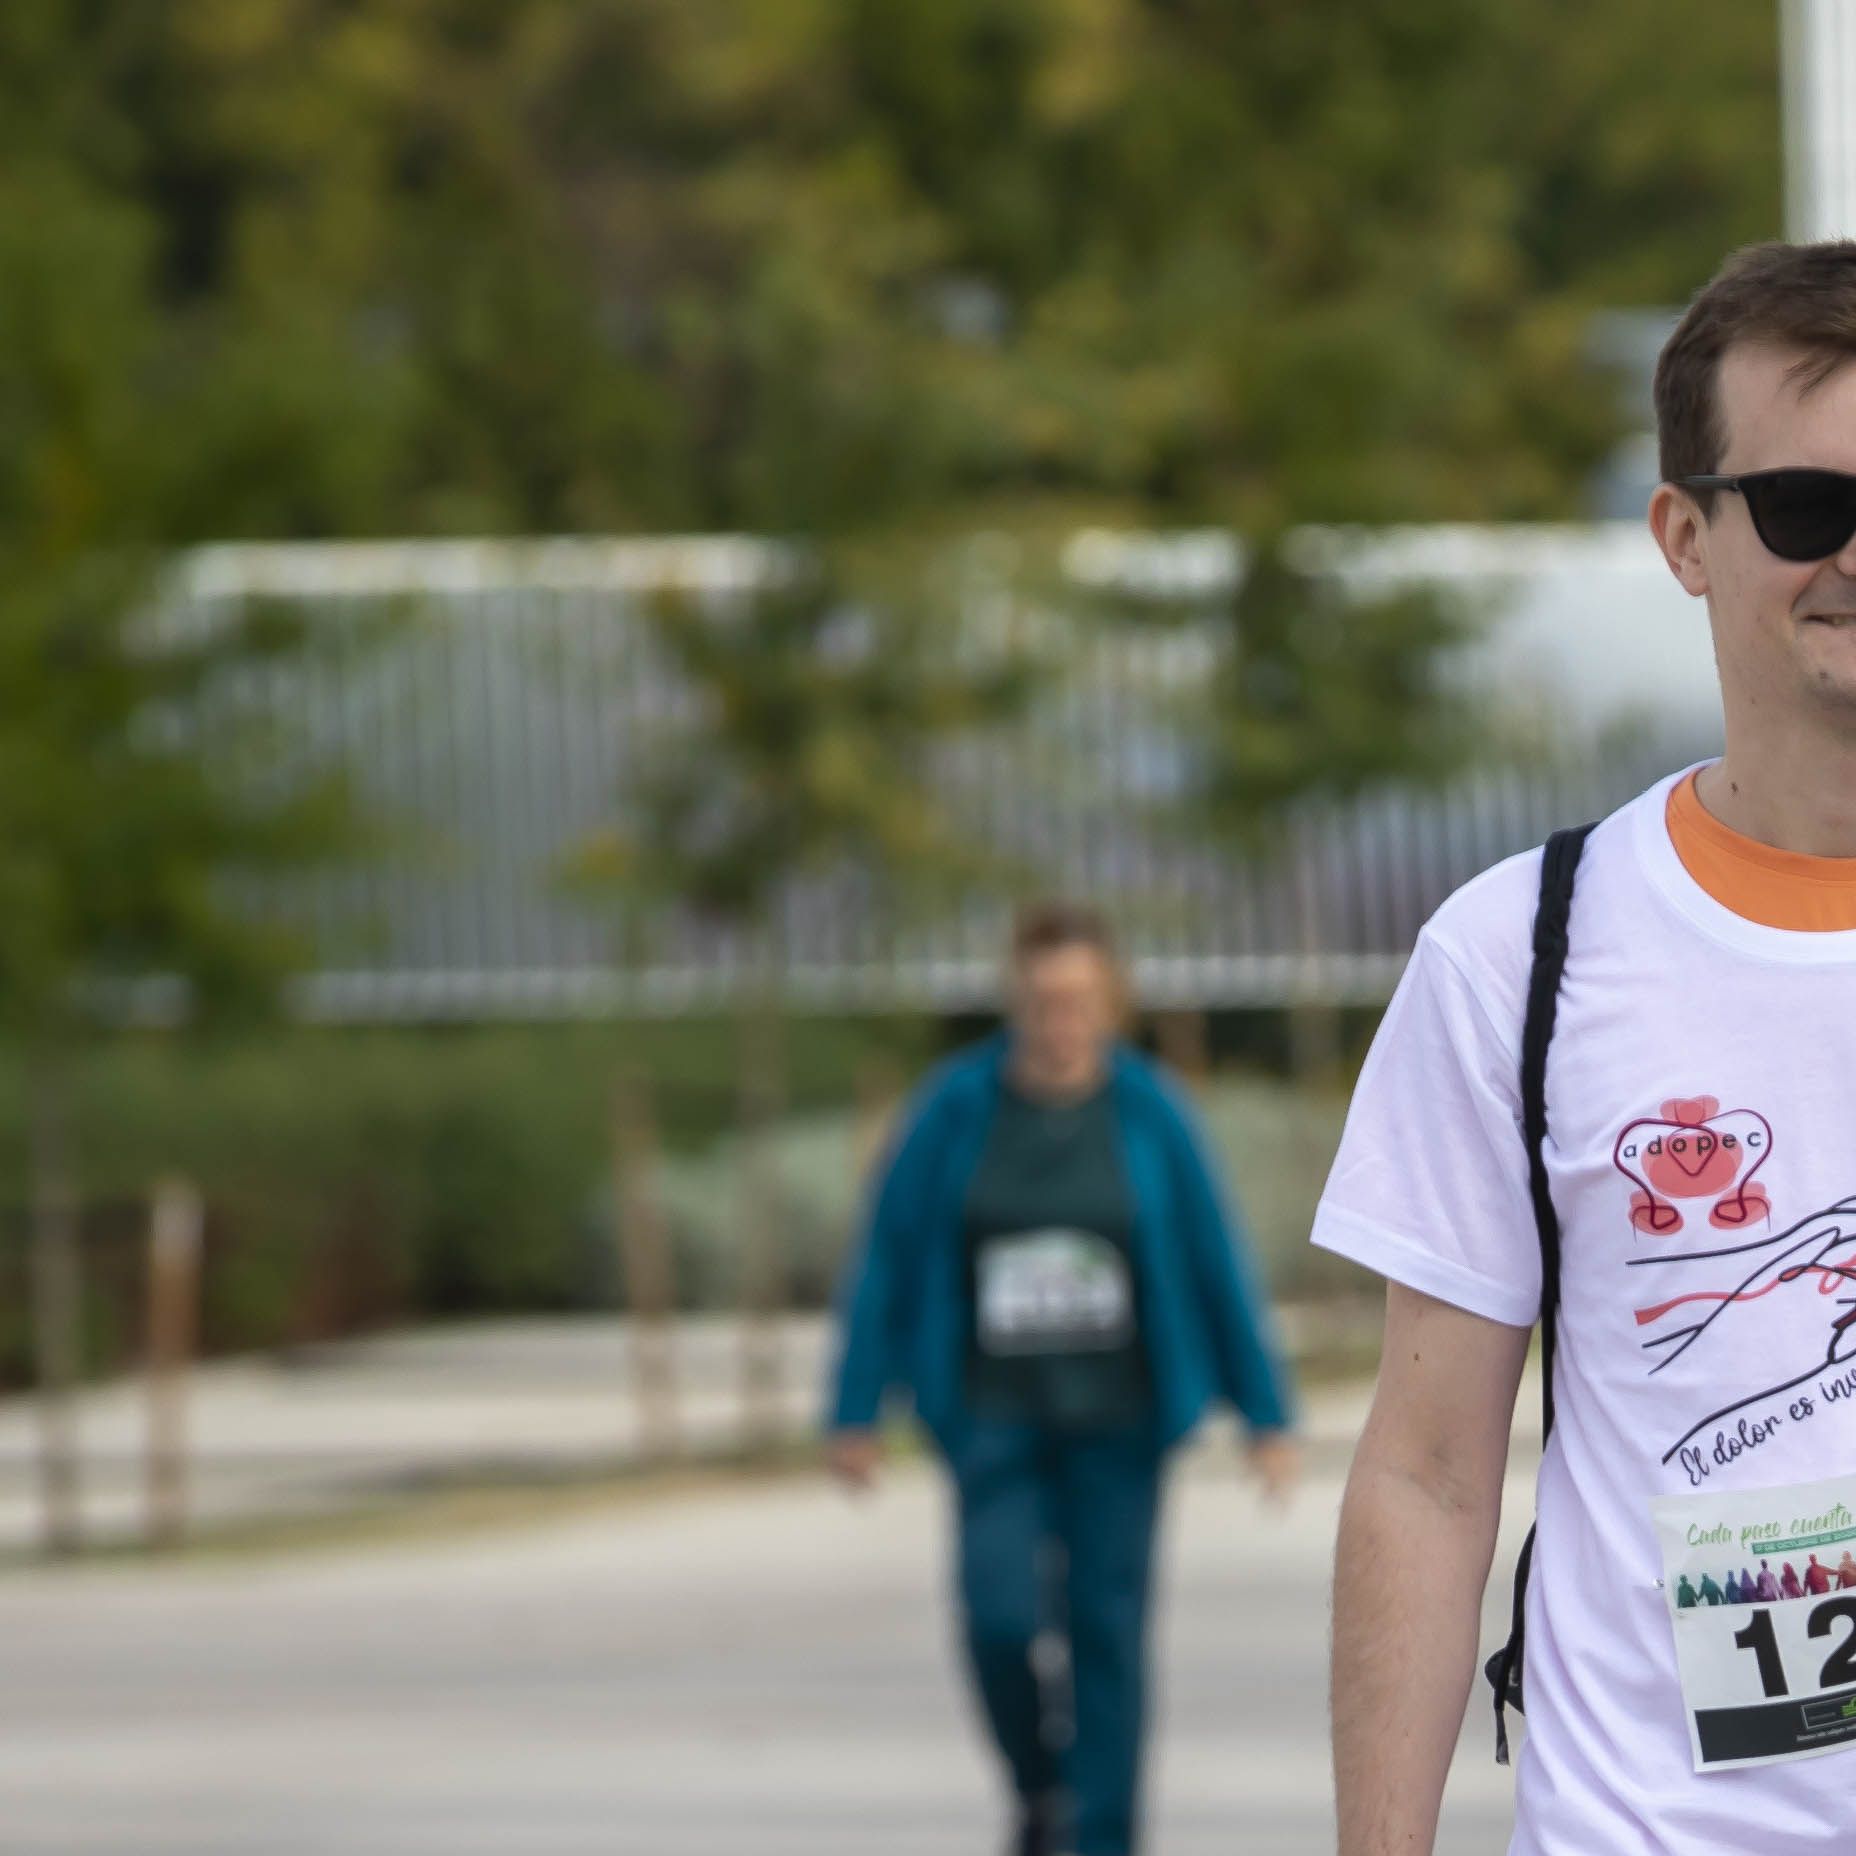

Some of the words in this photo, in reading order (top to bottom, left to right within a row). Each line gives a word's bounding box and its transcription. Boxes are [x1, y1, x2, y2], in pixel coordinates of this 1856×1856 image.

[1623, 1130, 1763, 1159] adopec
[1680, 1446, 1709, 1486] El
[1713, 1418, 1783, 1465] dolor
[1790, 1396, 1816, 1421] es
[1686, 1522, 1733, 1547] Cada
[1740, 1520, 1782, 1549] paso
[1790, 1503, 1853, 1536] cuenta
